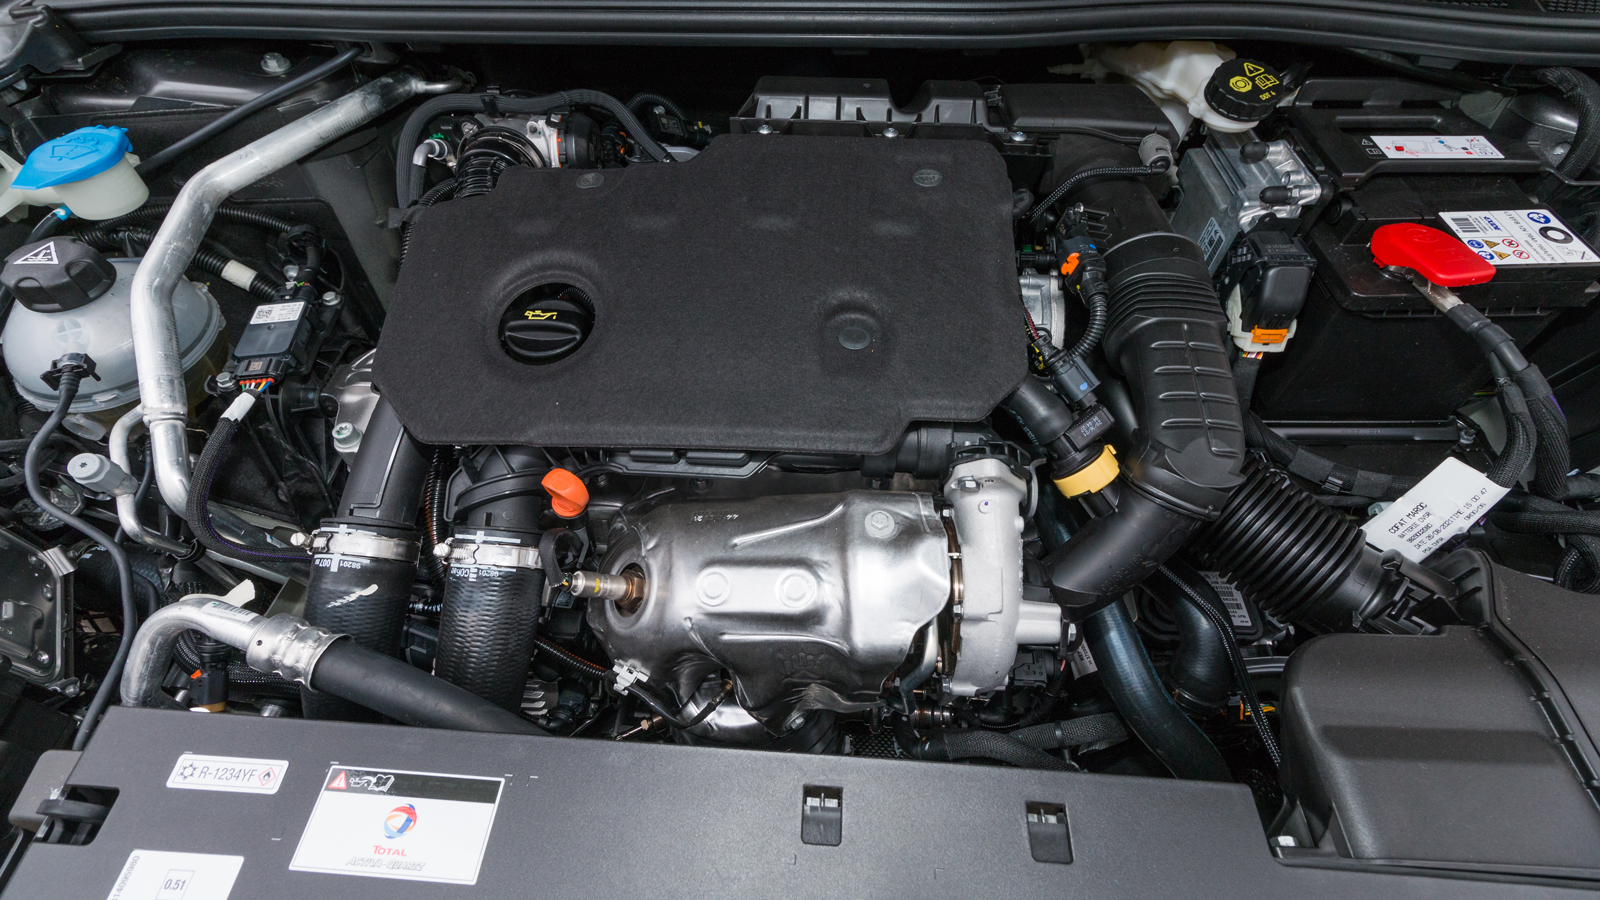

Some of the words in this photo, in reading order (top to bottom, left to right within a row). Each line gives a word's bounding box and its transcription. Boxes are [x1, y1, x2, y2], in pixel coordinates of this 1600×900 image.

[1259, 92, 1271, 100] DOT
[1388, 517, 1408, 535] COFAT
[1406, 502, 1428, 520] MAROC
[1398, 521, 1420, 539] BATTERIE
[198, 765, 258, 782] R-1234YF
[373, 845, 408, 857] TOTAL
[163, 878, 187, 891] 0.51
